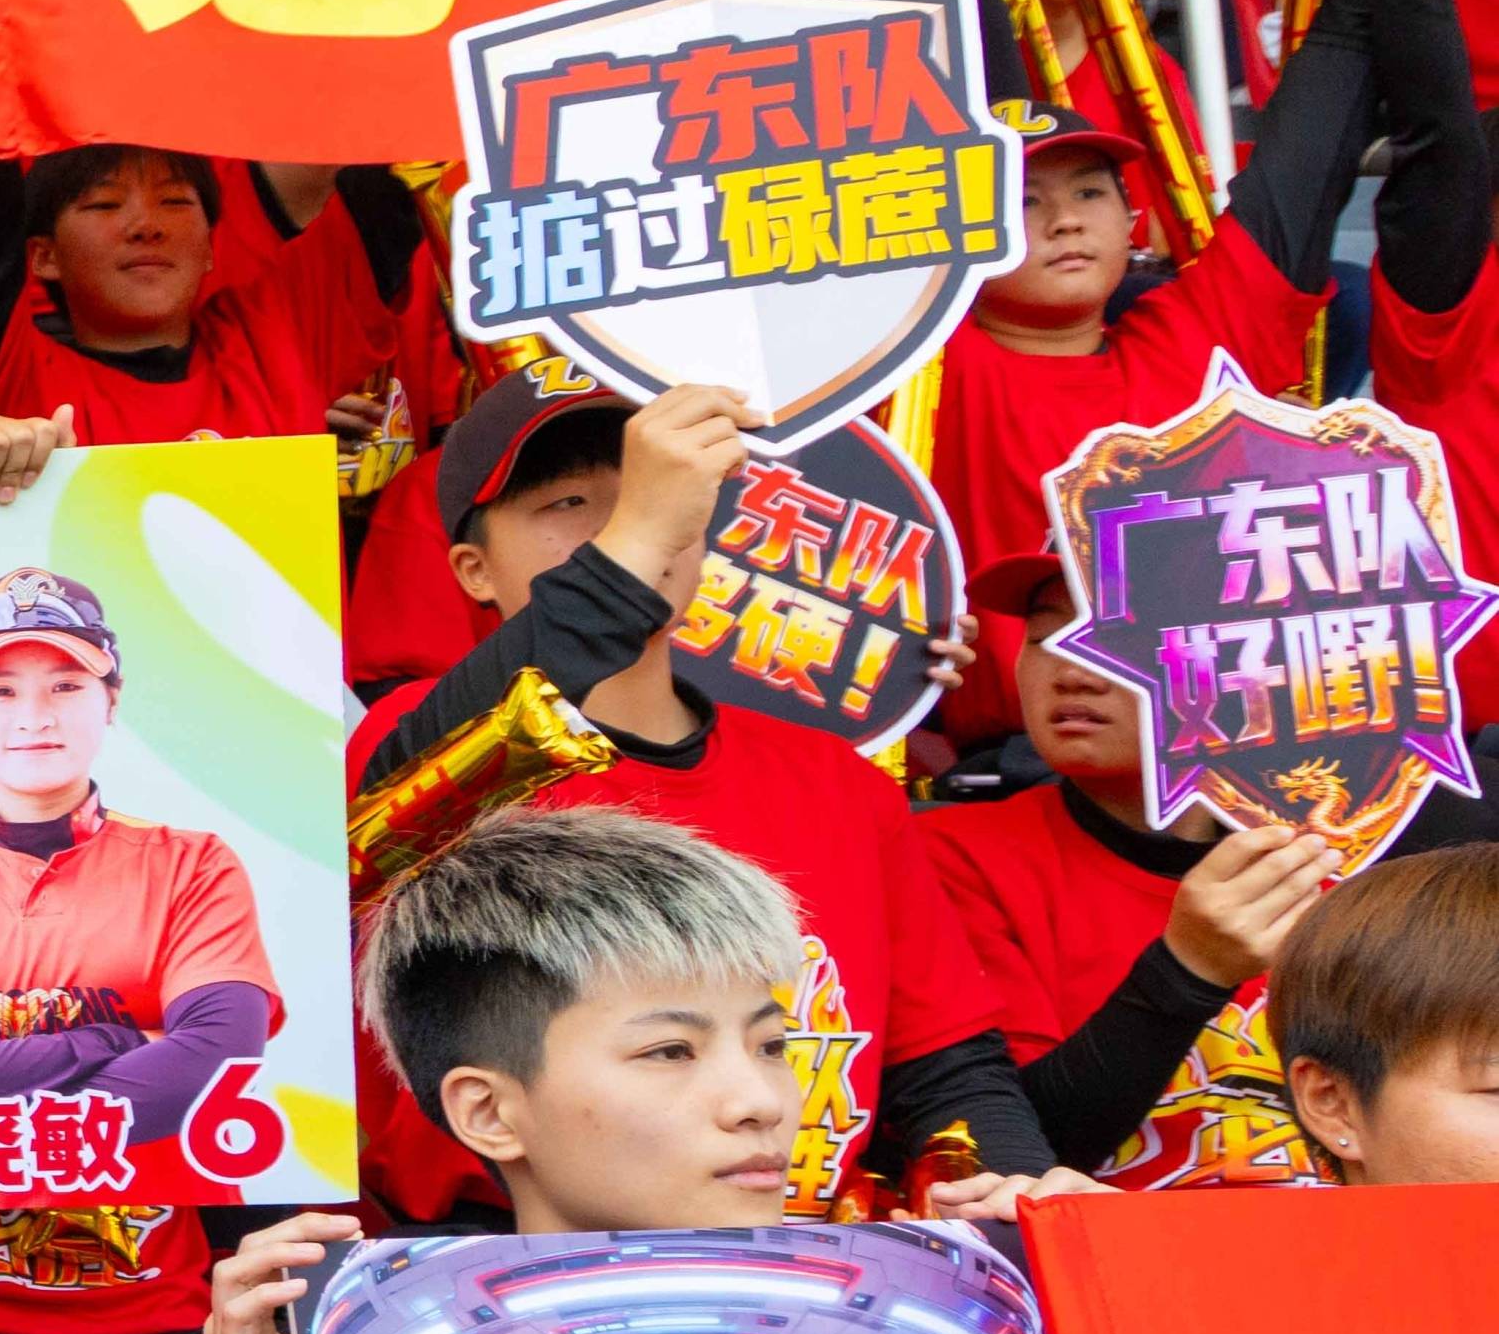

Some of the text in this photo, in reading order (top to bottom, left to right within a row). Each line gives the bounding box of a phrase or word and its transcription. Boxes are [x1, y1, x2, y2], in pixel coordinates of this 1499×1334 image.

[509, 22, 973, 191] 广东队
[715, 459, 936, 635] 东队
[1088, 465, 1455, 621] 广东队
[181, 1057, 292, 1185] 6
